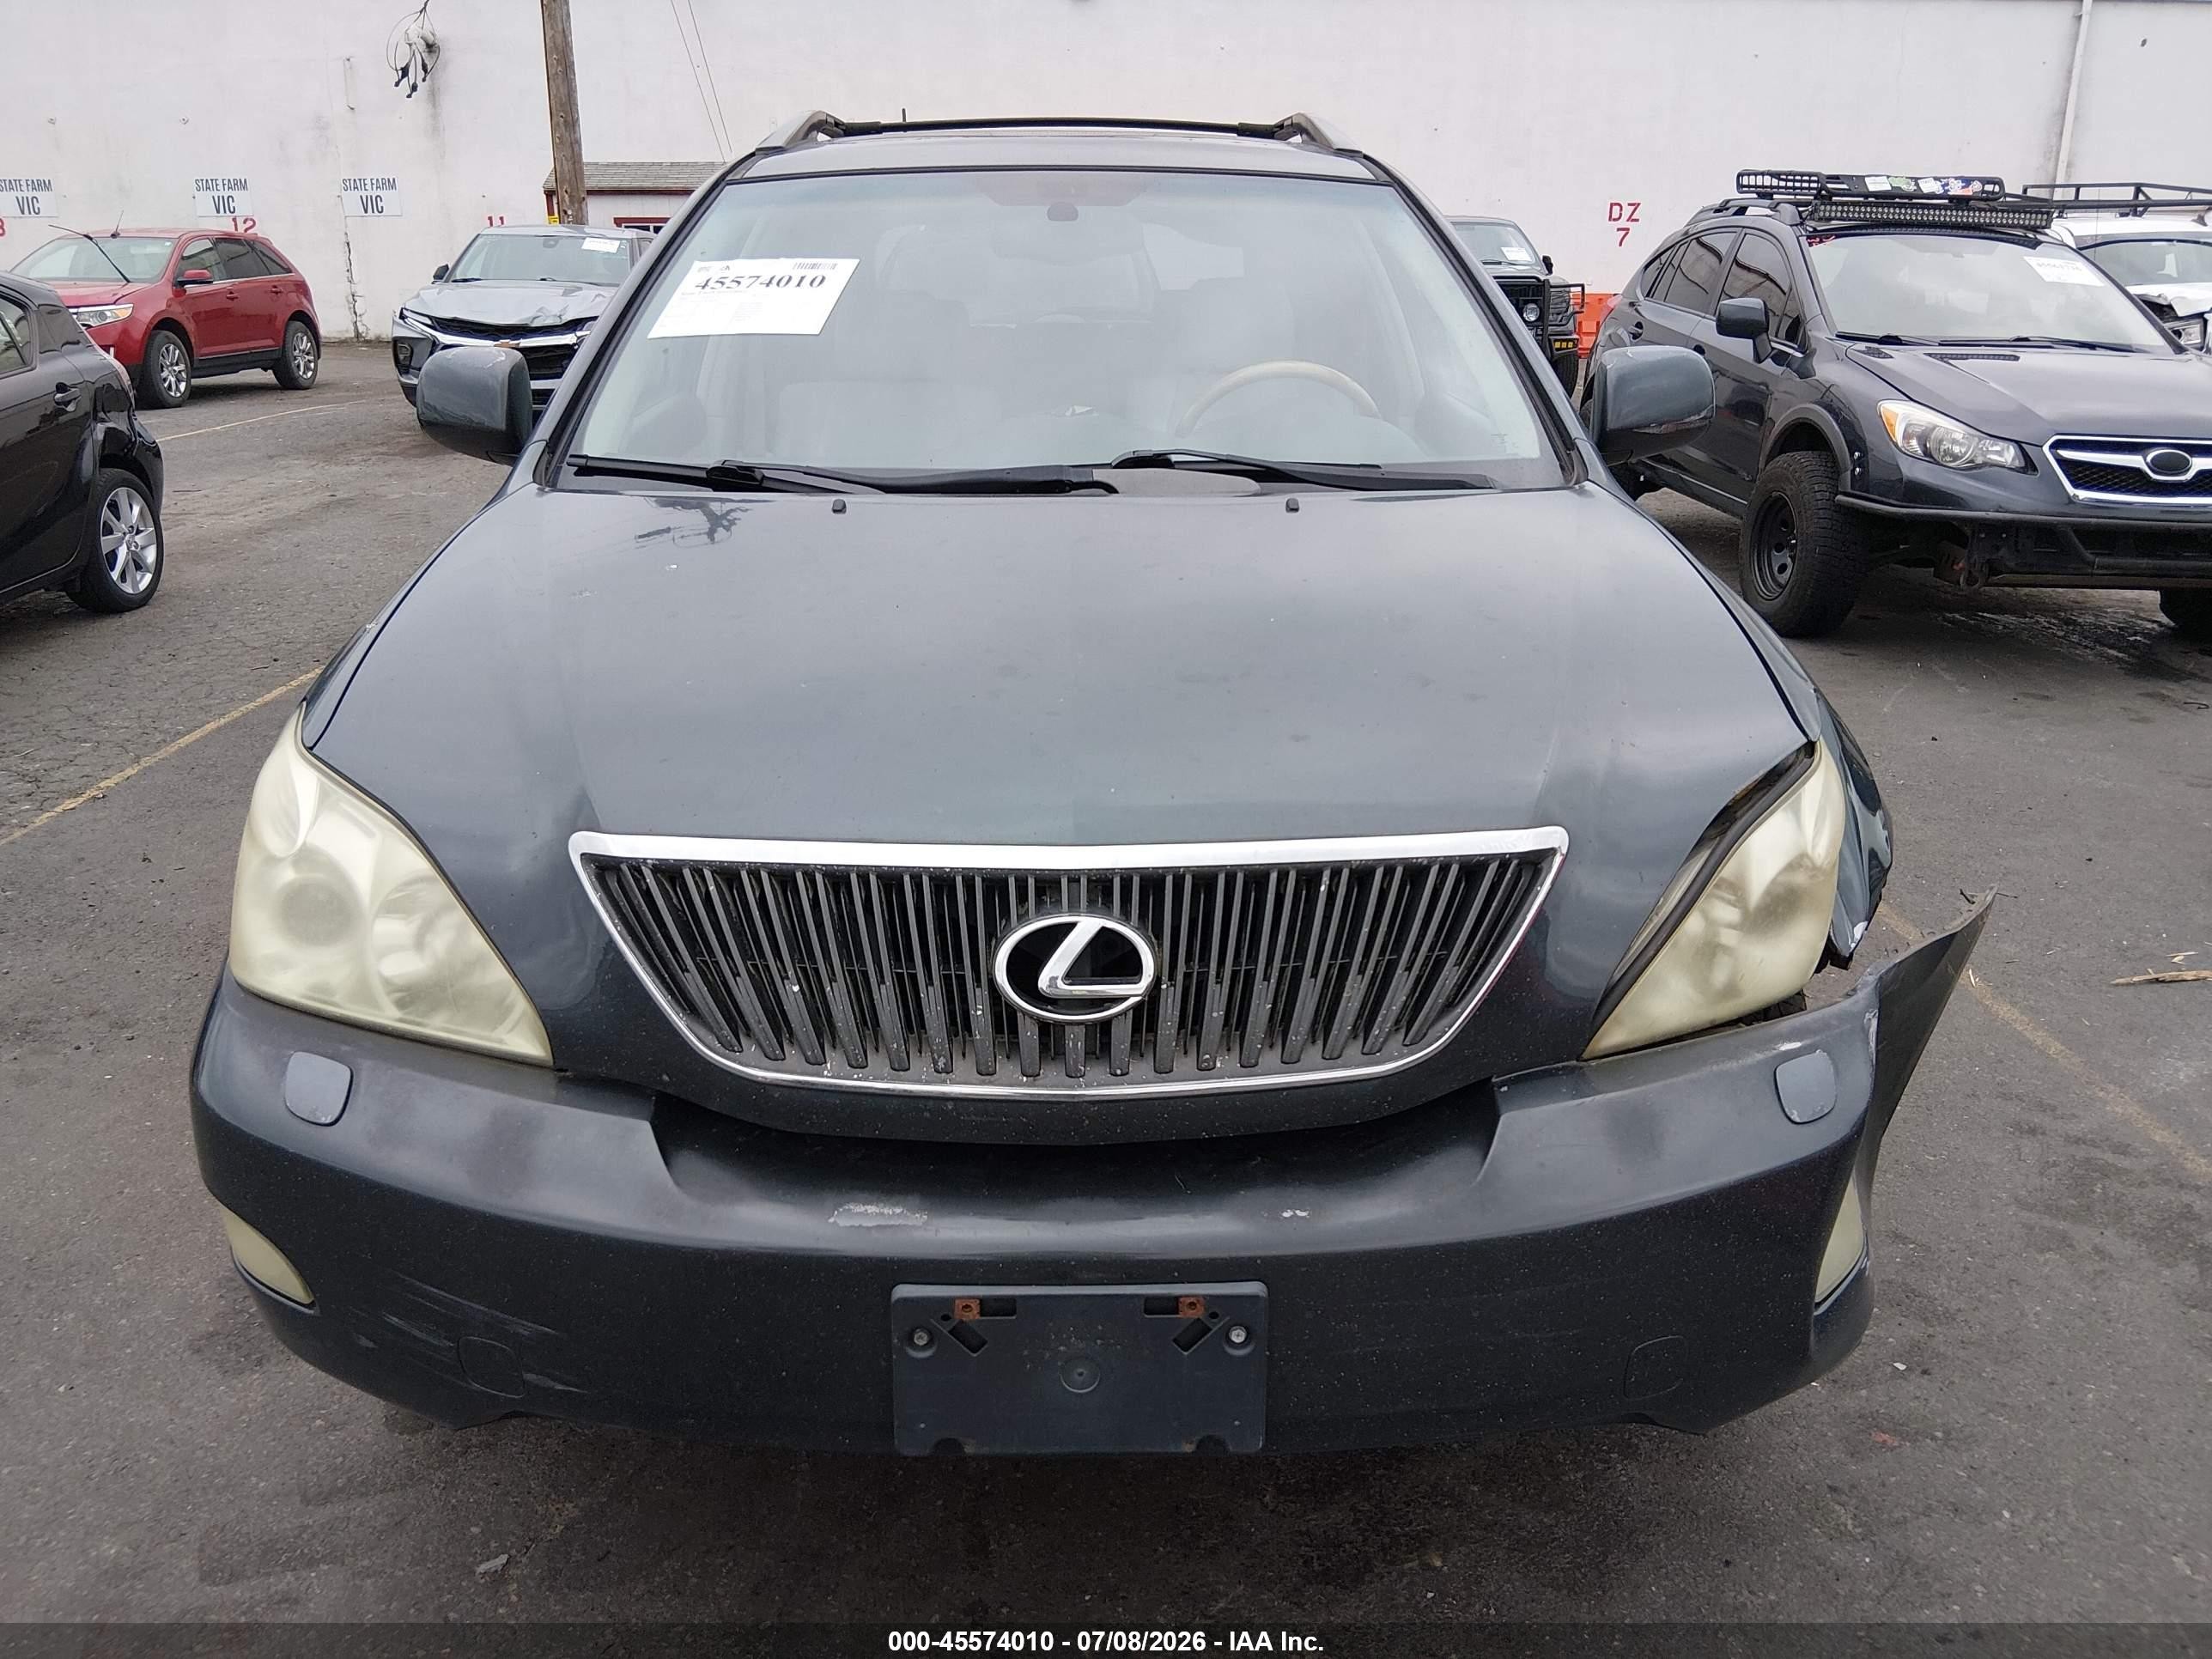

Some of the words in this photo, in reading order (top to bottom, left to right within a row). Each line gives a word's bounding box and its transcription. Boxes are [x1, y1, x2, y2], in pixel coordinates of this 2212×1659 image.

[0, 179, 24, 192] STATE
[26, 179, 52, 192] FARM
[195, 179, 220, 191] STATE
[222, 178, 248, 191] FARM
[342, 178, 368, 191] STATE
[369, 177, 397, 191] FARM
[15, 196, 40, 215] VIC
[212, 195, 236, 214] VIC
[360, 194, 384, 214] VIC
[1608, 202, 1641, 222] DZ
[1616, 227, 1631, 247] 7
[694, 274, 827, 290] 45574010
